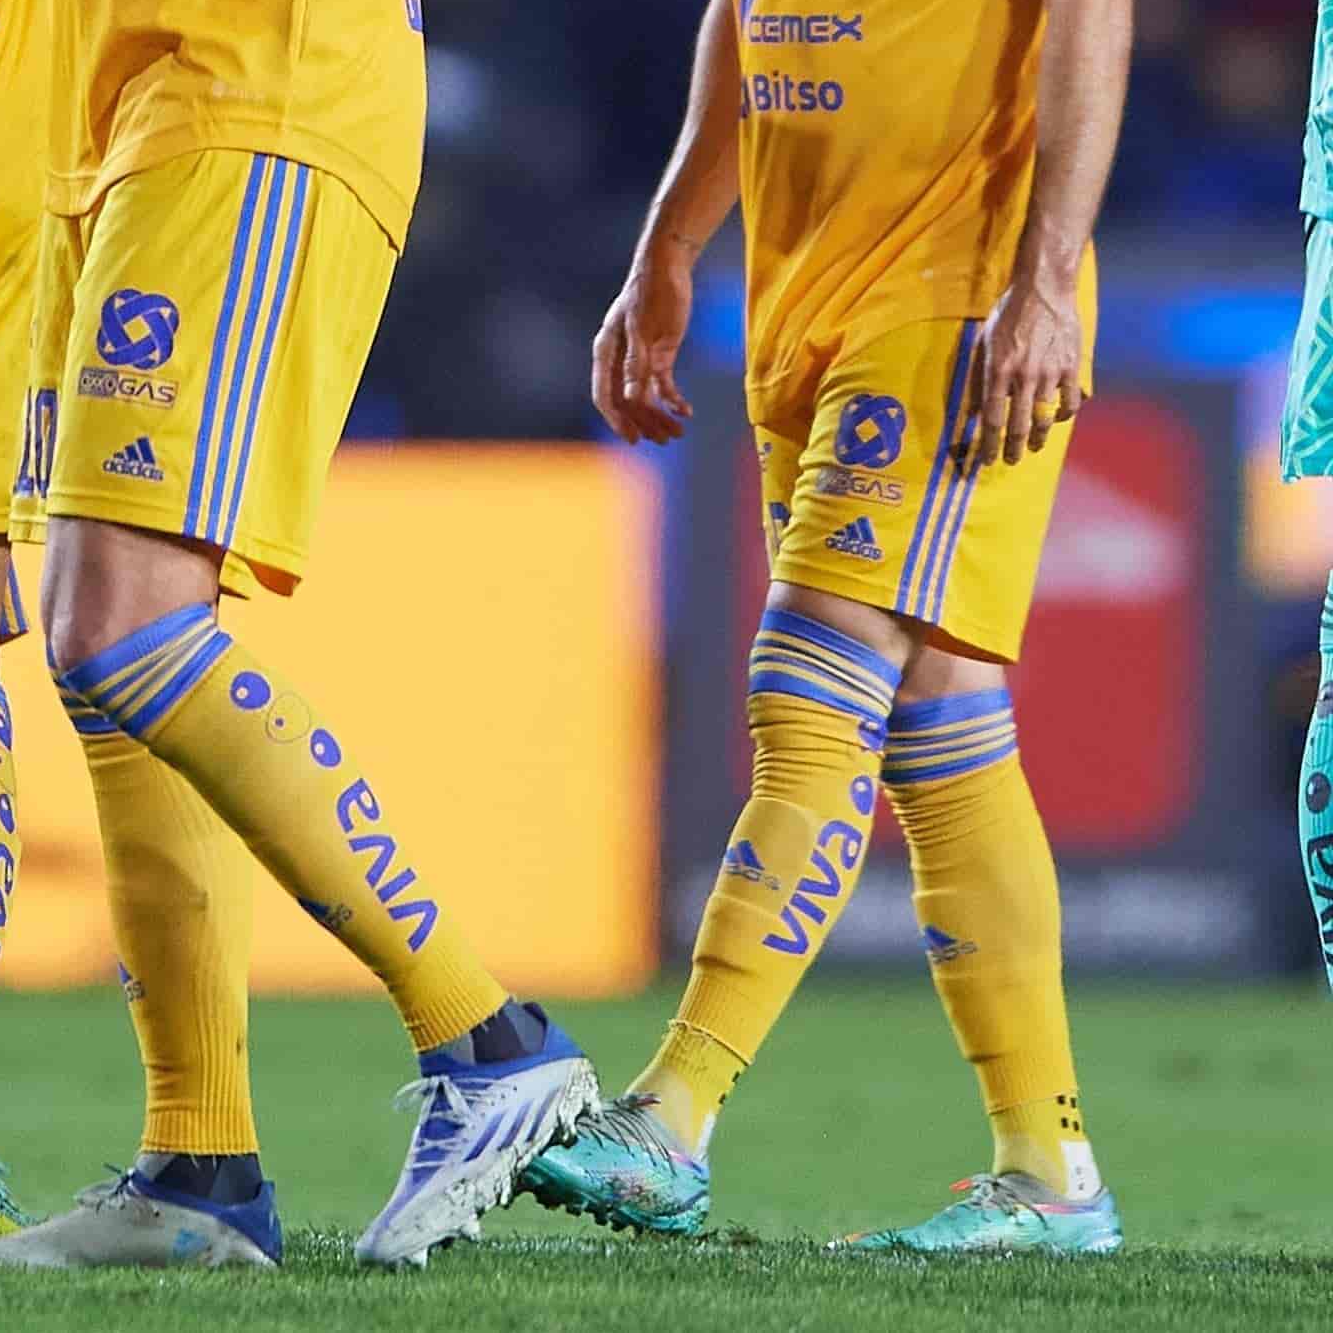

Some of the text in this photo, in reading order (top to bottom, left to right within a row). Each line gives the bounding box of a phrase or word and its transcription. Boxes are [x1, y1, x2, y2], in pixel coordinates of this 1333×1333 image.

[749, 14, 863, 43] CEMEX
[752, 69, 845, 112] Bitso
[117, 377, 178, 404] GAS
[334, 776, 439, 954] viva
[761, 818, 865, 957] viva
